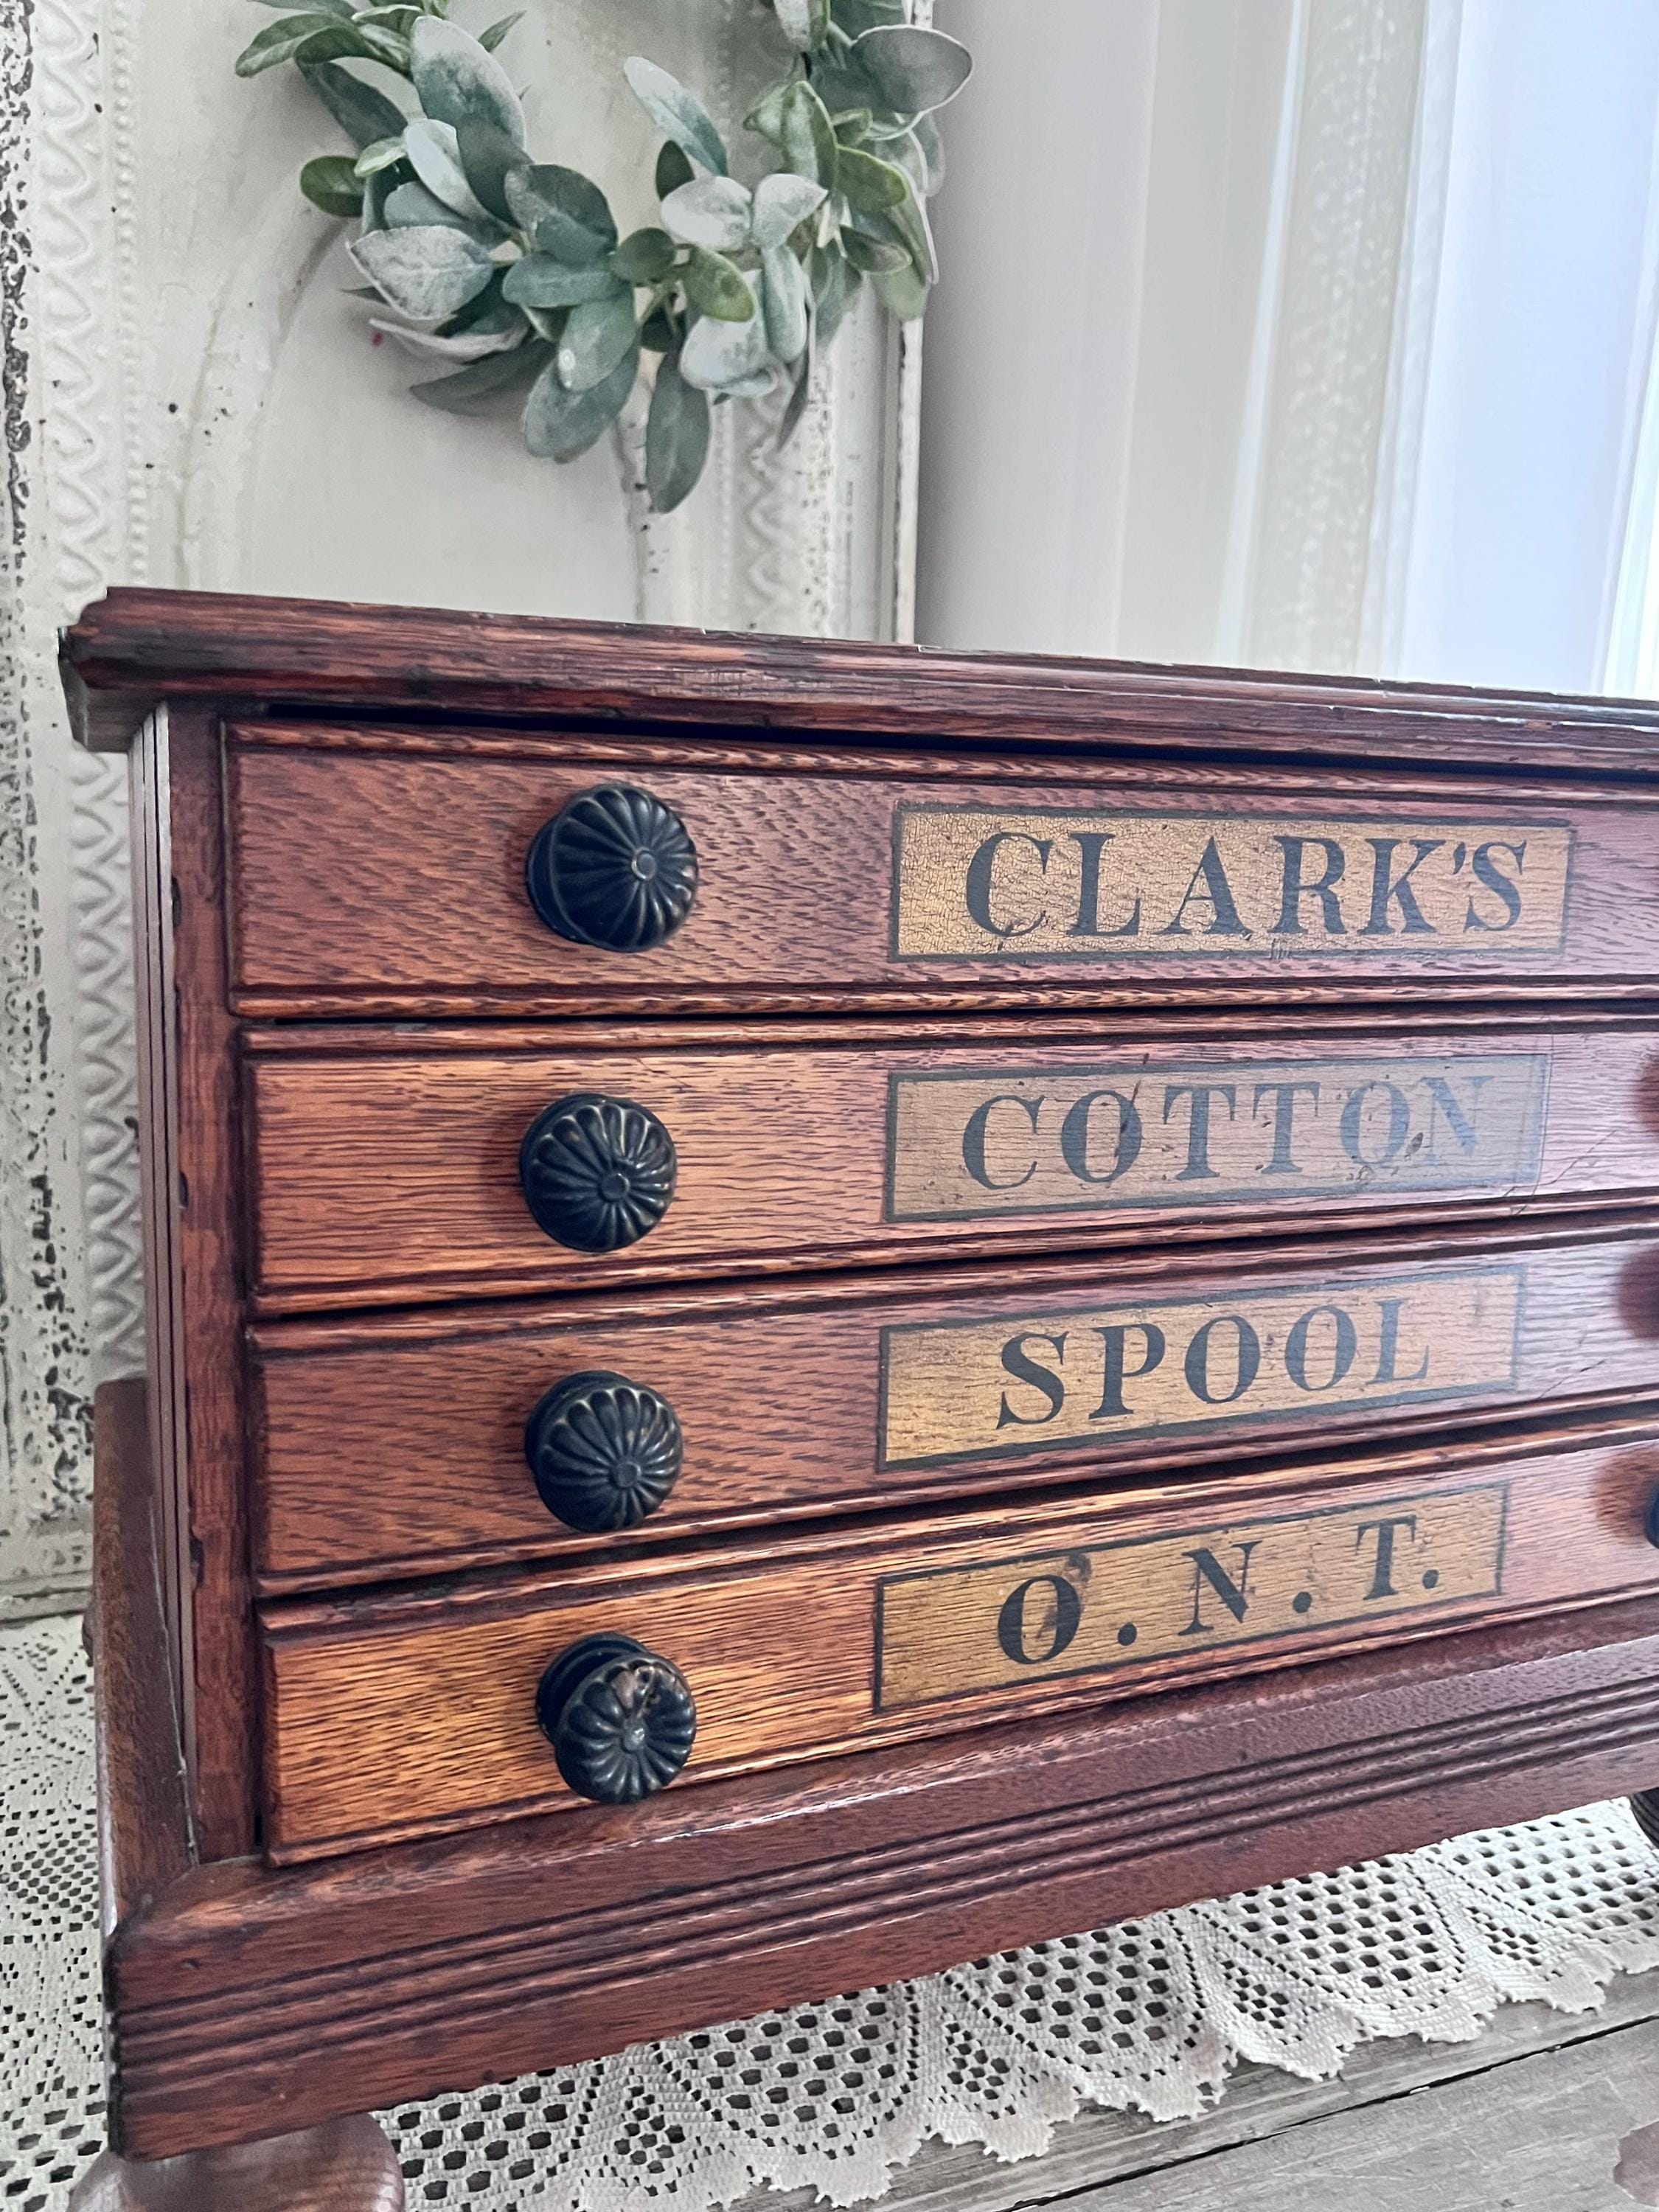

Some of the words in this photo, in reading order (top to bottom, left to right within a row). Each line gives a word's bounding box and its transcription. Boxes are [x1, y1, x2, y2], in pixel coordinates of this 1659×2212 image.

[965, 831, 1527, 937] CLARK'S
[961, 1074, 1495, 1191] COTTON
[995, 1298, 1430, 1430] SPOOL
